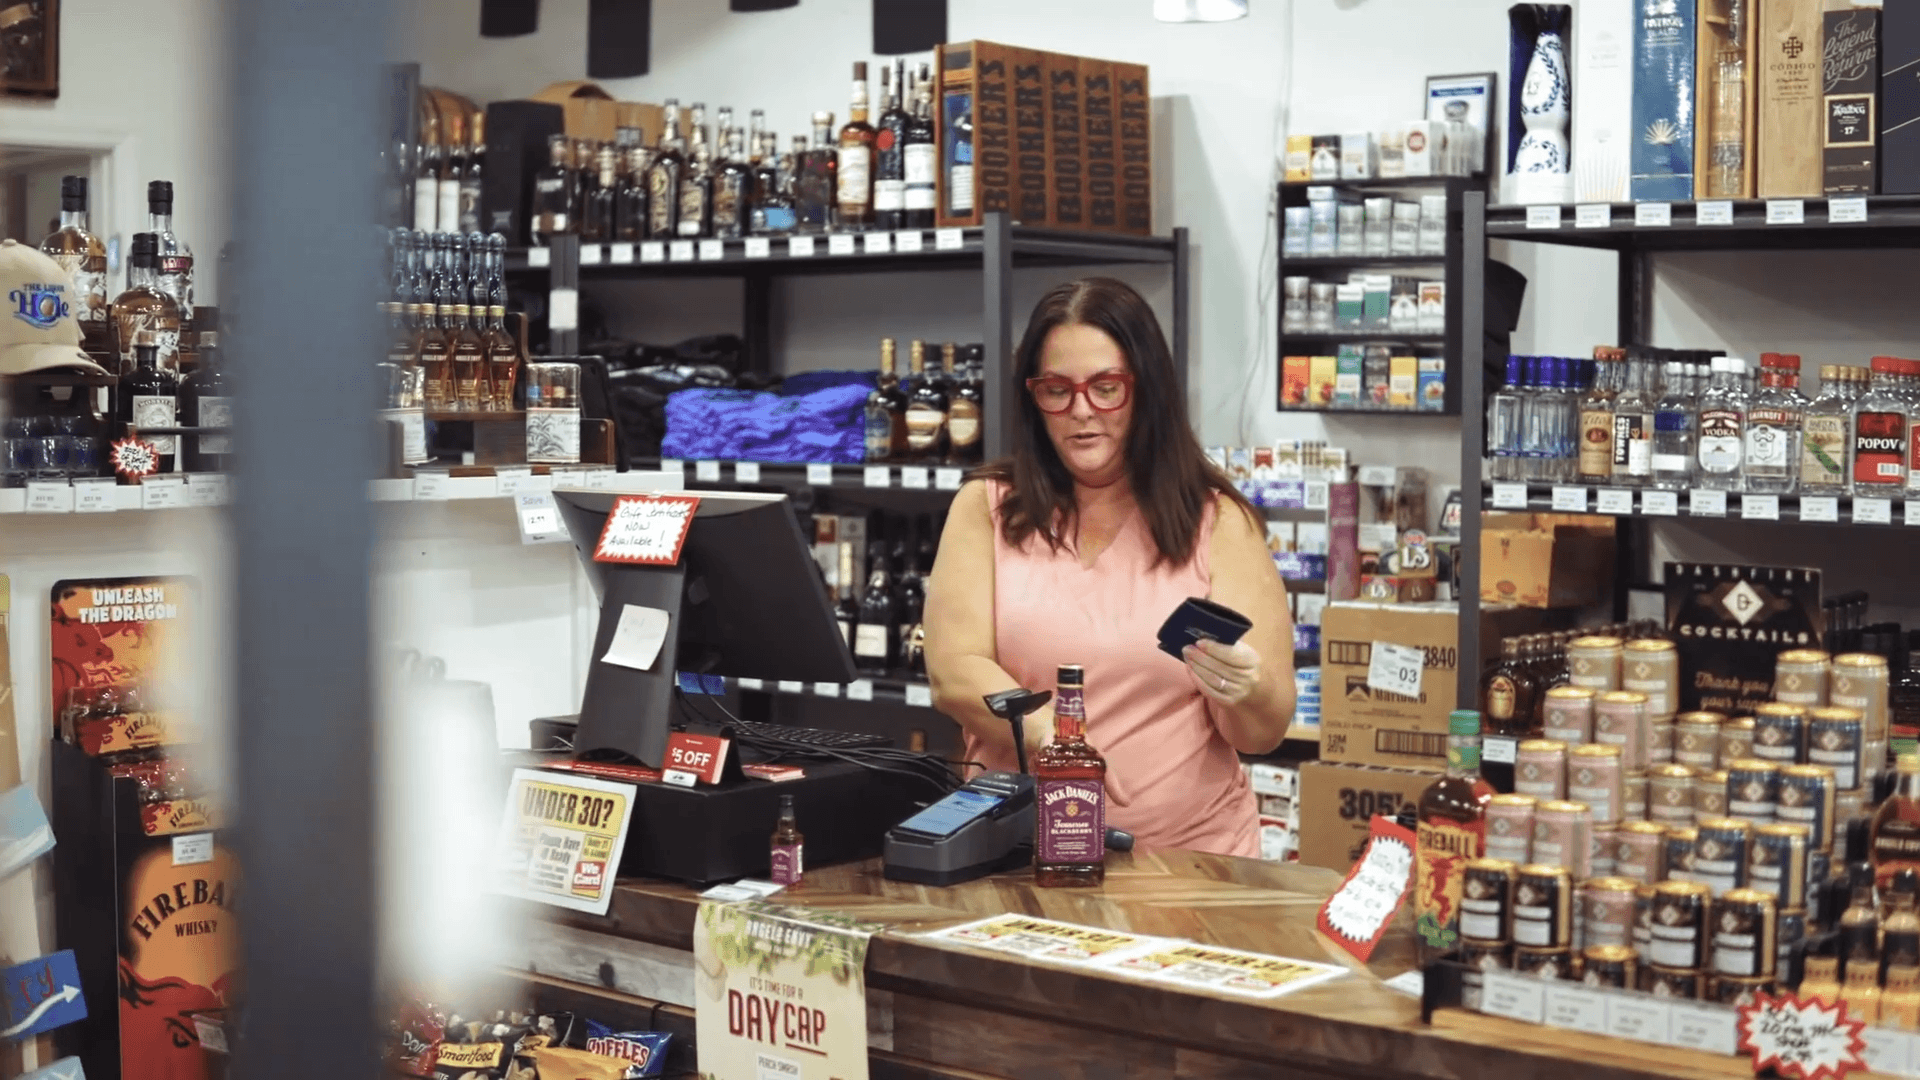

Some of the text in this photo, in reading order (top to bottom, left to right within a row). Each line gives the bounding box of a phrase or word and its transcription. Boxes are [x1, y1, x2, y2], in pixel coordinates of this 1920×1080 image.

[1823, 19, 1876, 59] Legend
[1834, 20, 1858, 40] The
[1770, 62, 1816, 71] CÓDIGO
[1844, 126, 1855, 135] 17
[1705, 428, 1736, 437] VODKA
[1857, 437, 1899, 450] POPOV
[1675, 563, 1812, 583] DASHFIRE
[92, 586, 165, 607] UNLEASH
[79, 603, 178, 624] THE DRAGON
[1679, 624, 1809, 645] COCKTAILS
[1399, 667, 1418, 684] 03
[1742, 681, 1769, 697] you
[671, 747, 712, 766] $5 OFF
[1044, 788, 1066, 806] JACK
[523, 785, 615, 829] UNDER 30?
[174, 920, 218, 937] WHISKY
[750, 976, 763, 992] IT'S
[764, 979, 781, 995] TIME
[782, 983, 797, 998] FOR
[437, 1047, 496, 1064] Smartfood
[757, 1055, 799, 1076] PEACH SMASH
